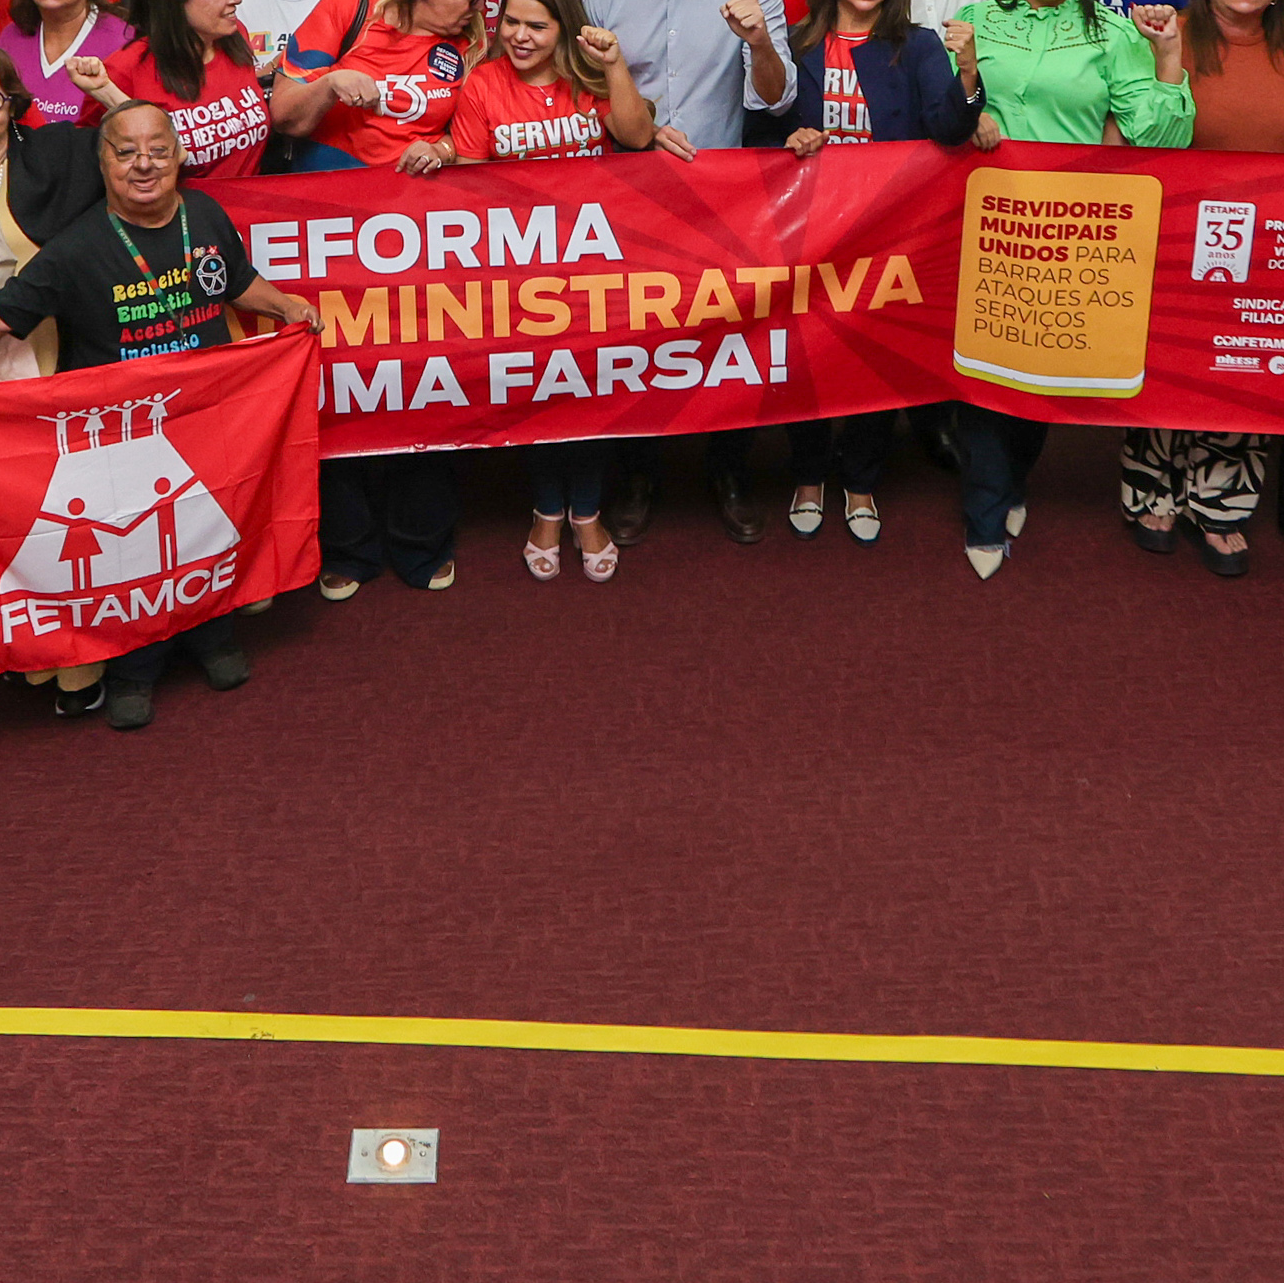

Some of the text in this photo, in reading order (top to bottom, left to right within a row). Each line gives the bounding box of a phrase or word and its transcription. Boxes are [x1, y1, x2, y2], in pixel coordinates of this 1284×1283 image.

[33, 98, 78, 115] oletivo
[239, 86, 261, 109] JÁ
[426, 87, 452, 100] ANOS
[185, 124, 268, 166] ANTIPOVO
[494, 108, 603, 157] SERVIÇO
[981, 195, 1134, 220] SERVIDORES
[1204, 205, 1250, 216] FETAMCE
[250, 203, 623, 281] EFORMA
[980, 216, 1118, 241] MUNICIPAIS
[1204, 218, 1245, 251] 35
[979, 237, 1137, 264] UNIDOS PARA
[1207, 251, 1236, 260] anos
[978, 257, 1110, 285] BARRAR OS
[284, 254, 923, 348] MINISTRATIVA
[975, 278, 1134, 308] ATAQUES AOS
[974, 298, 1086, 331] SERVIÇOS
[974, 318, 1091, 350] PÚBLICOS.
[319, 329, 788, 414] MA FARSA!
[1, 552, 236, 644] FETAMCE
